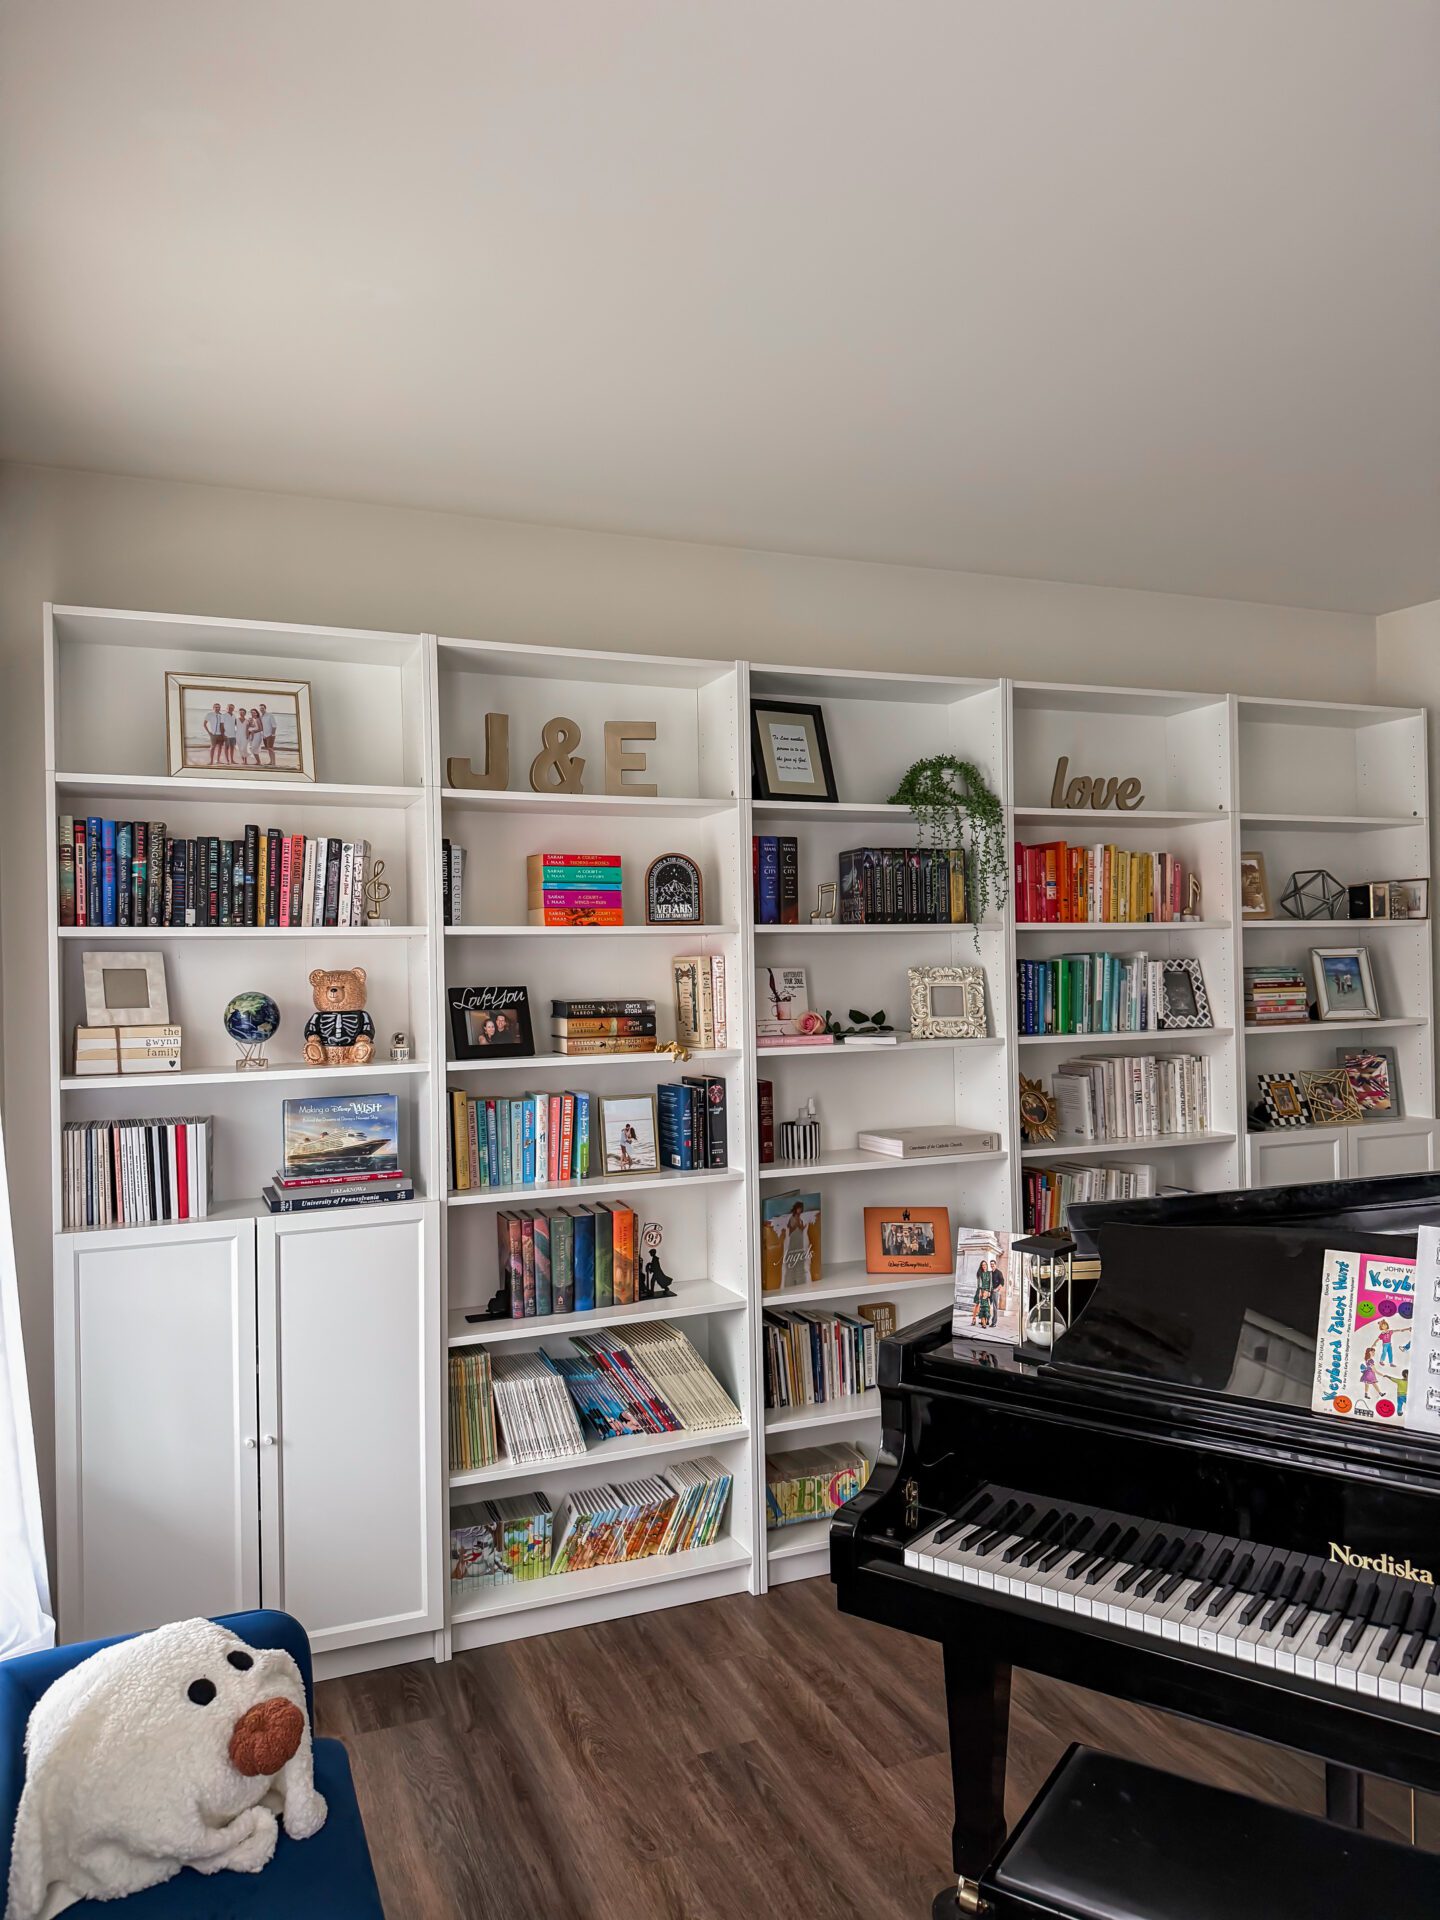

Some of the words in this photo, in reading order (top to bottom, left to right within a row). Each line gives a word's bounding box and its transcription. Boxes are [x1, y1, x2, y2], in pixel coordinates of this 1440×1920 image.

[447, 713, 509, 790] J
[530, 717, 586, 794] &
[604, 721, 657, 797] E
[1051, 756, 1145, 810] love
[293, 861, 301, 880] COAST
[656, 903, 693, 914] VELARIS
[163, 1028, 180, 1036] the
[145, 1038, 179, 1047] gwynn
[147, 1048, 179, 1058] family
[301, 1197, 332, 1208] University
[341, 1194, 380, 1205] Pennsylvania
[1332, 1260, 1350, 1290] Hunt
[872, 1308, 890, 1321] YOUR
[1327, 1295, 1347, 1335] Talent
[1322, 1339, 1343, 1401] Keyboard
[1327, 1541, 1435, 1585] Nordiska
